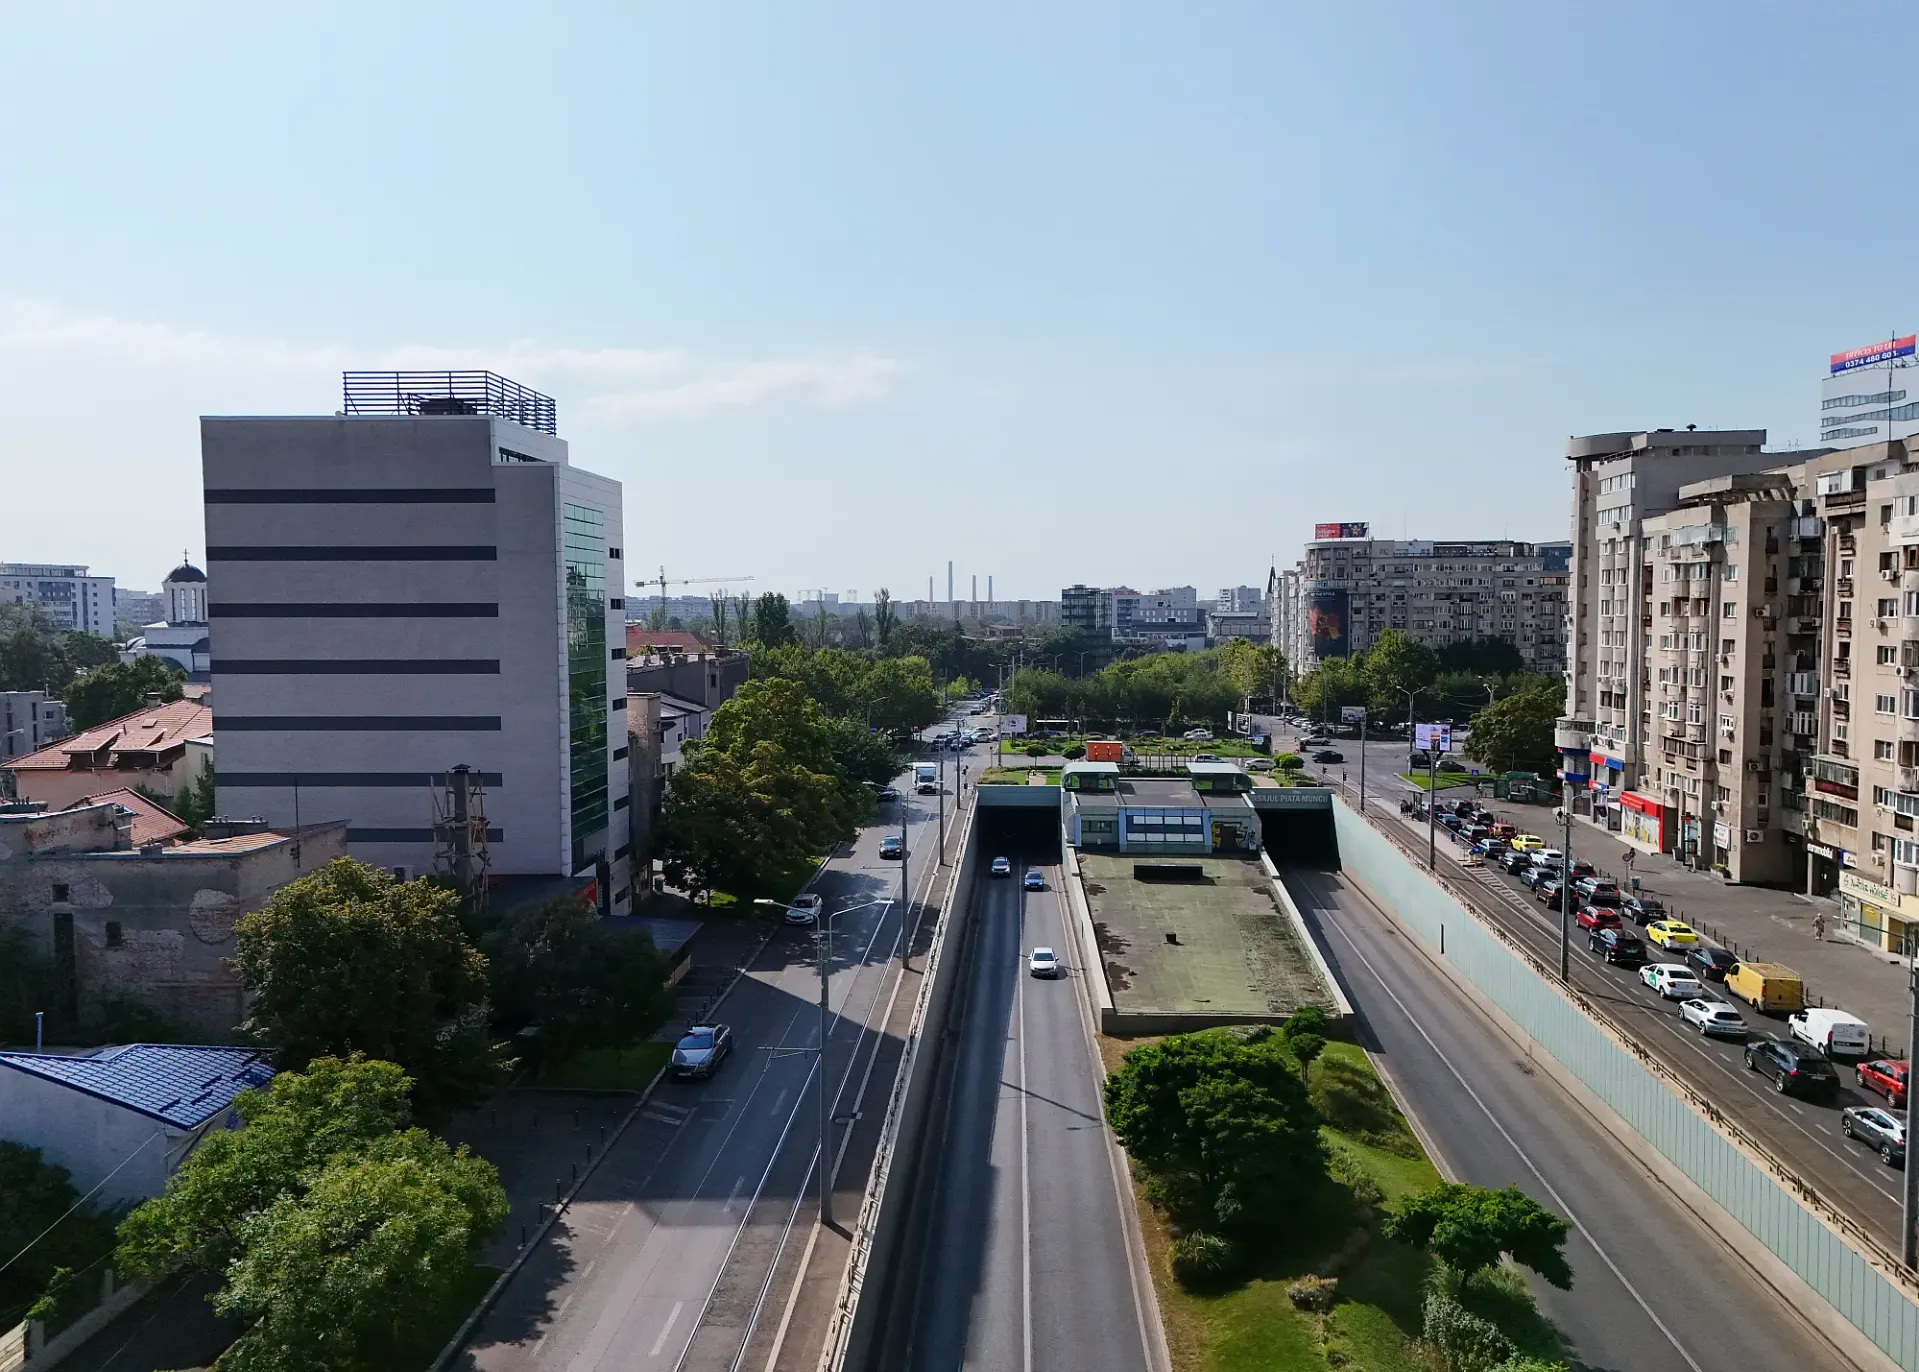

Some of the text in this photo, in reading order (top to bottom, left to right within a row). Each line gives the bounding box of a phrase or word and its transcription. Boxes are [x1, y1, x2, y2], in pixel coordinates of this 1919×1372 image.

[1873, 344, 1883, 353] TO
[1845, 357, 1865, 368] 0374
[1866, 354, 1880, 363] 480
